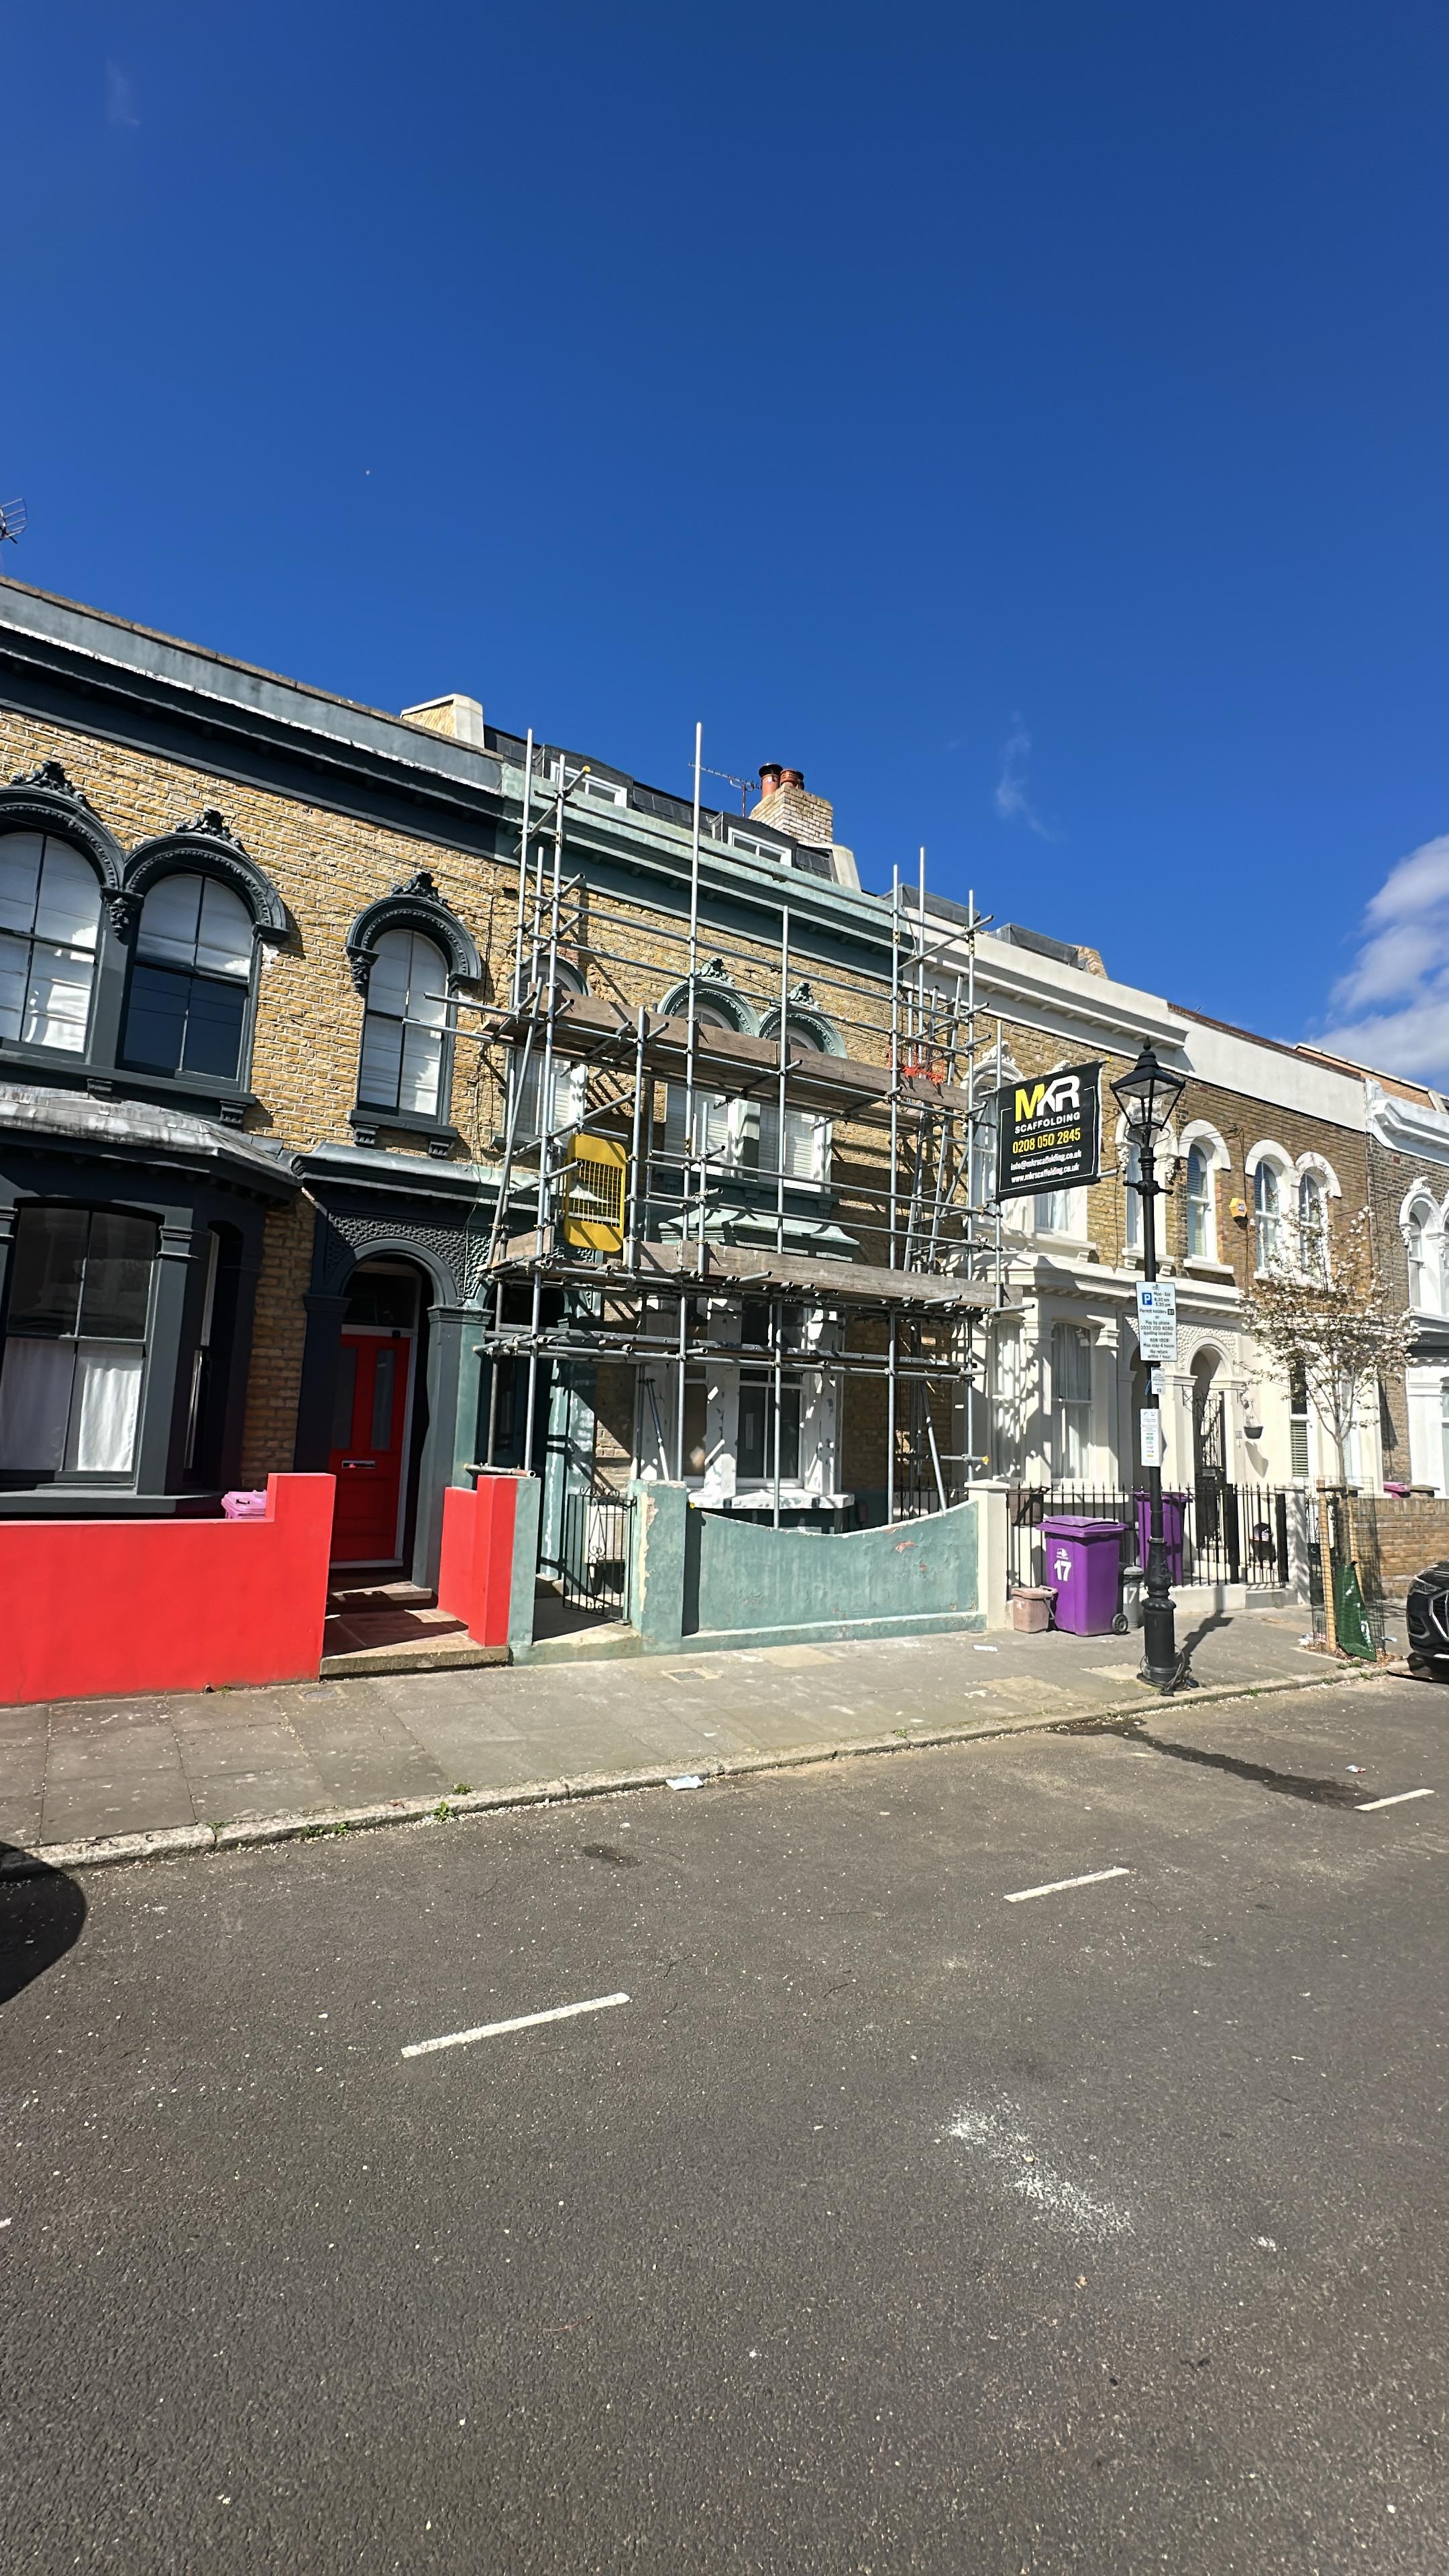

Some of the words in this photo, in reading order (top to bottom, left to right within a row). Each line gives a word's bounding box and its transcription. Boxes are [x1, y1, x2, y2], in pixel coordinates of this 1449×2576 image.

[1015, 1075, 1080, 1122] MKR
[1014, 1112, 1081, 1134] SCAFFOLDING
[1012, 1138, 1035, 1154] 0208
[1037, 1133, 1055, 1148] 050
[1057, 1128, 1081, 1144] 2845
[1144, 1294, 1150, 1304] P
[1054, 1560, 1071, 1581] 17
[1123, 1587, 1137, 1604] 17
